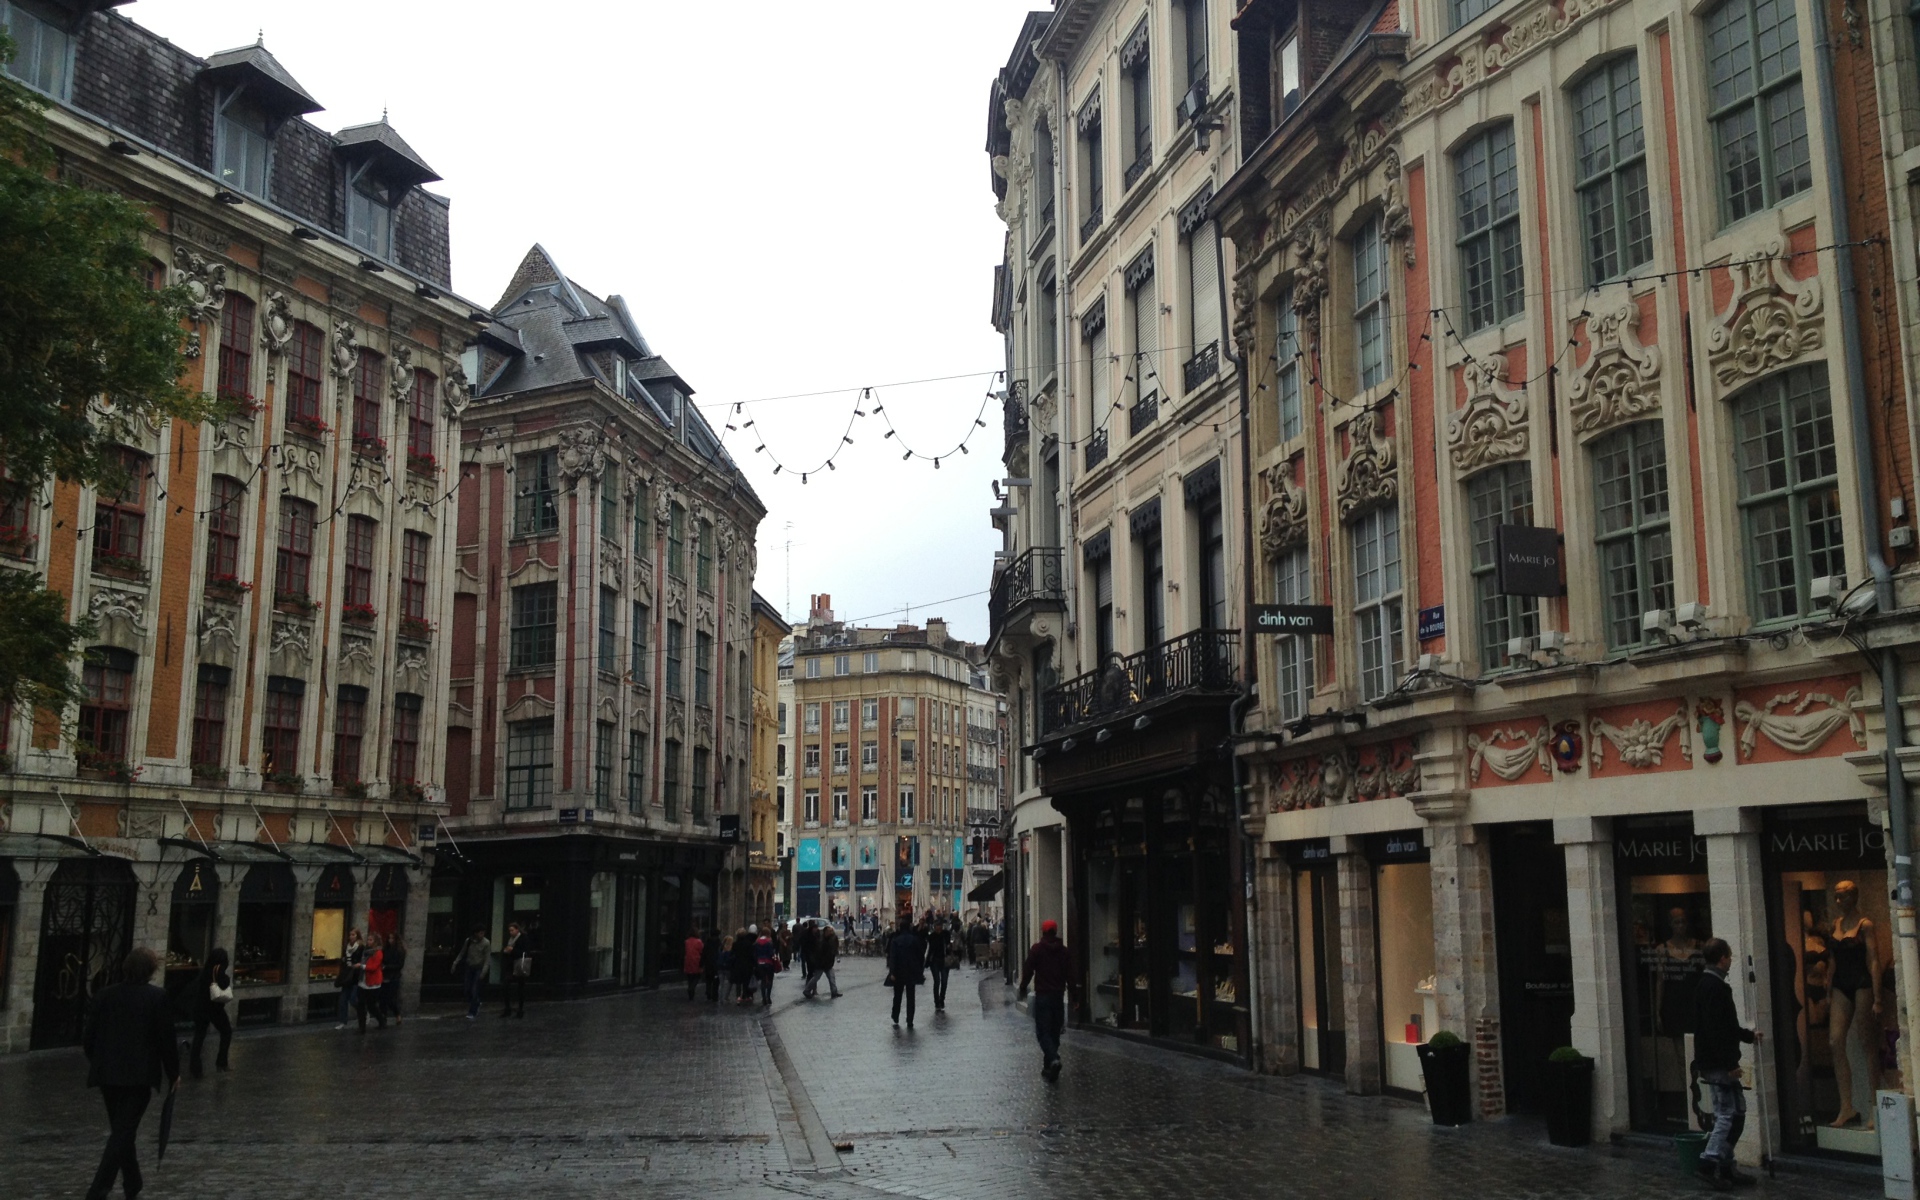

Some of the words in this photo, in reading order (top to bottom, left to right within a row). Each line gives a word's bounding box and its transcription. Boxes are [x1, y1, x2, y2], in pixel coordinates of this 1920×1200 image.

[1508, 552, 1542, 565] MARIE
[1257, 610, 1287, 626] dinh
[1288, 615, 1314, 626] van
[1387, 837, 1402, 853] dinh
[1403, 841, 1418, 852] van
[1617, 837, 1684, 858] MARIE
[1770, 831, 1851, 853] MARIE
[1316, 848, 1328, 858] van
[1525, 982, 1559, 990] Boutique
